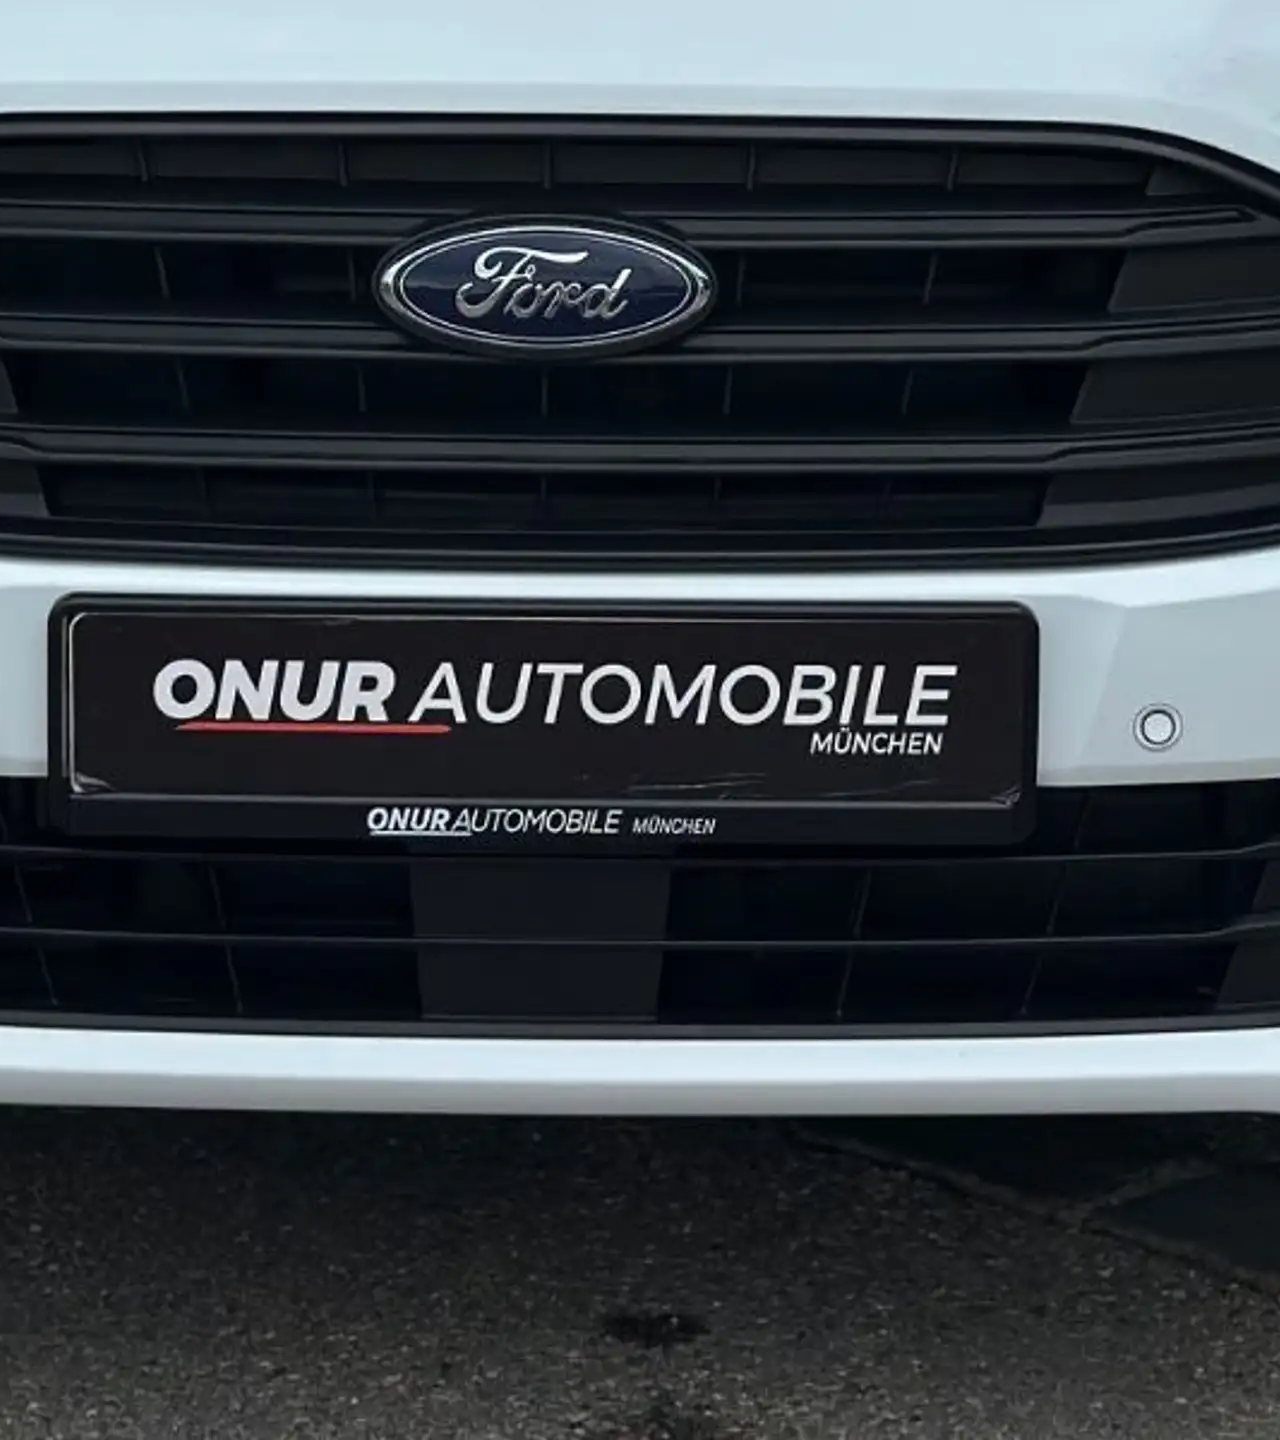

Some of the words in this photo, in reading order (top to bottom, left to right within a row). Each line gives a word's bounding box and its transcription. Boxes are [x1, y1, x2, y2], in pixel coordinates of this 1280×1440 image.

[454, 246, 632, 320] Ford
[152, 659, 397, 721] ONUR
[407, 662, 959, 726] AUTOMOBILE
[809, 726, 945, 756] MÜNCHEN
[366, 807, 451, 832] ONUR
[452, 808, 623, 834] AUTOMOBILE
[631, 815, 716, 835] MÜNCHEN
